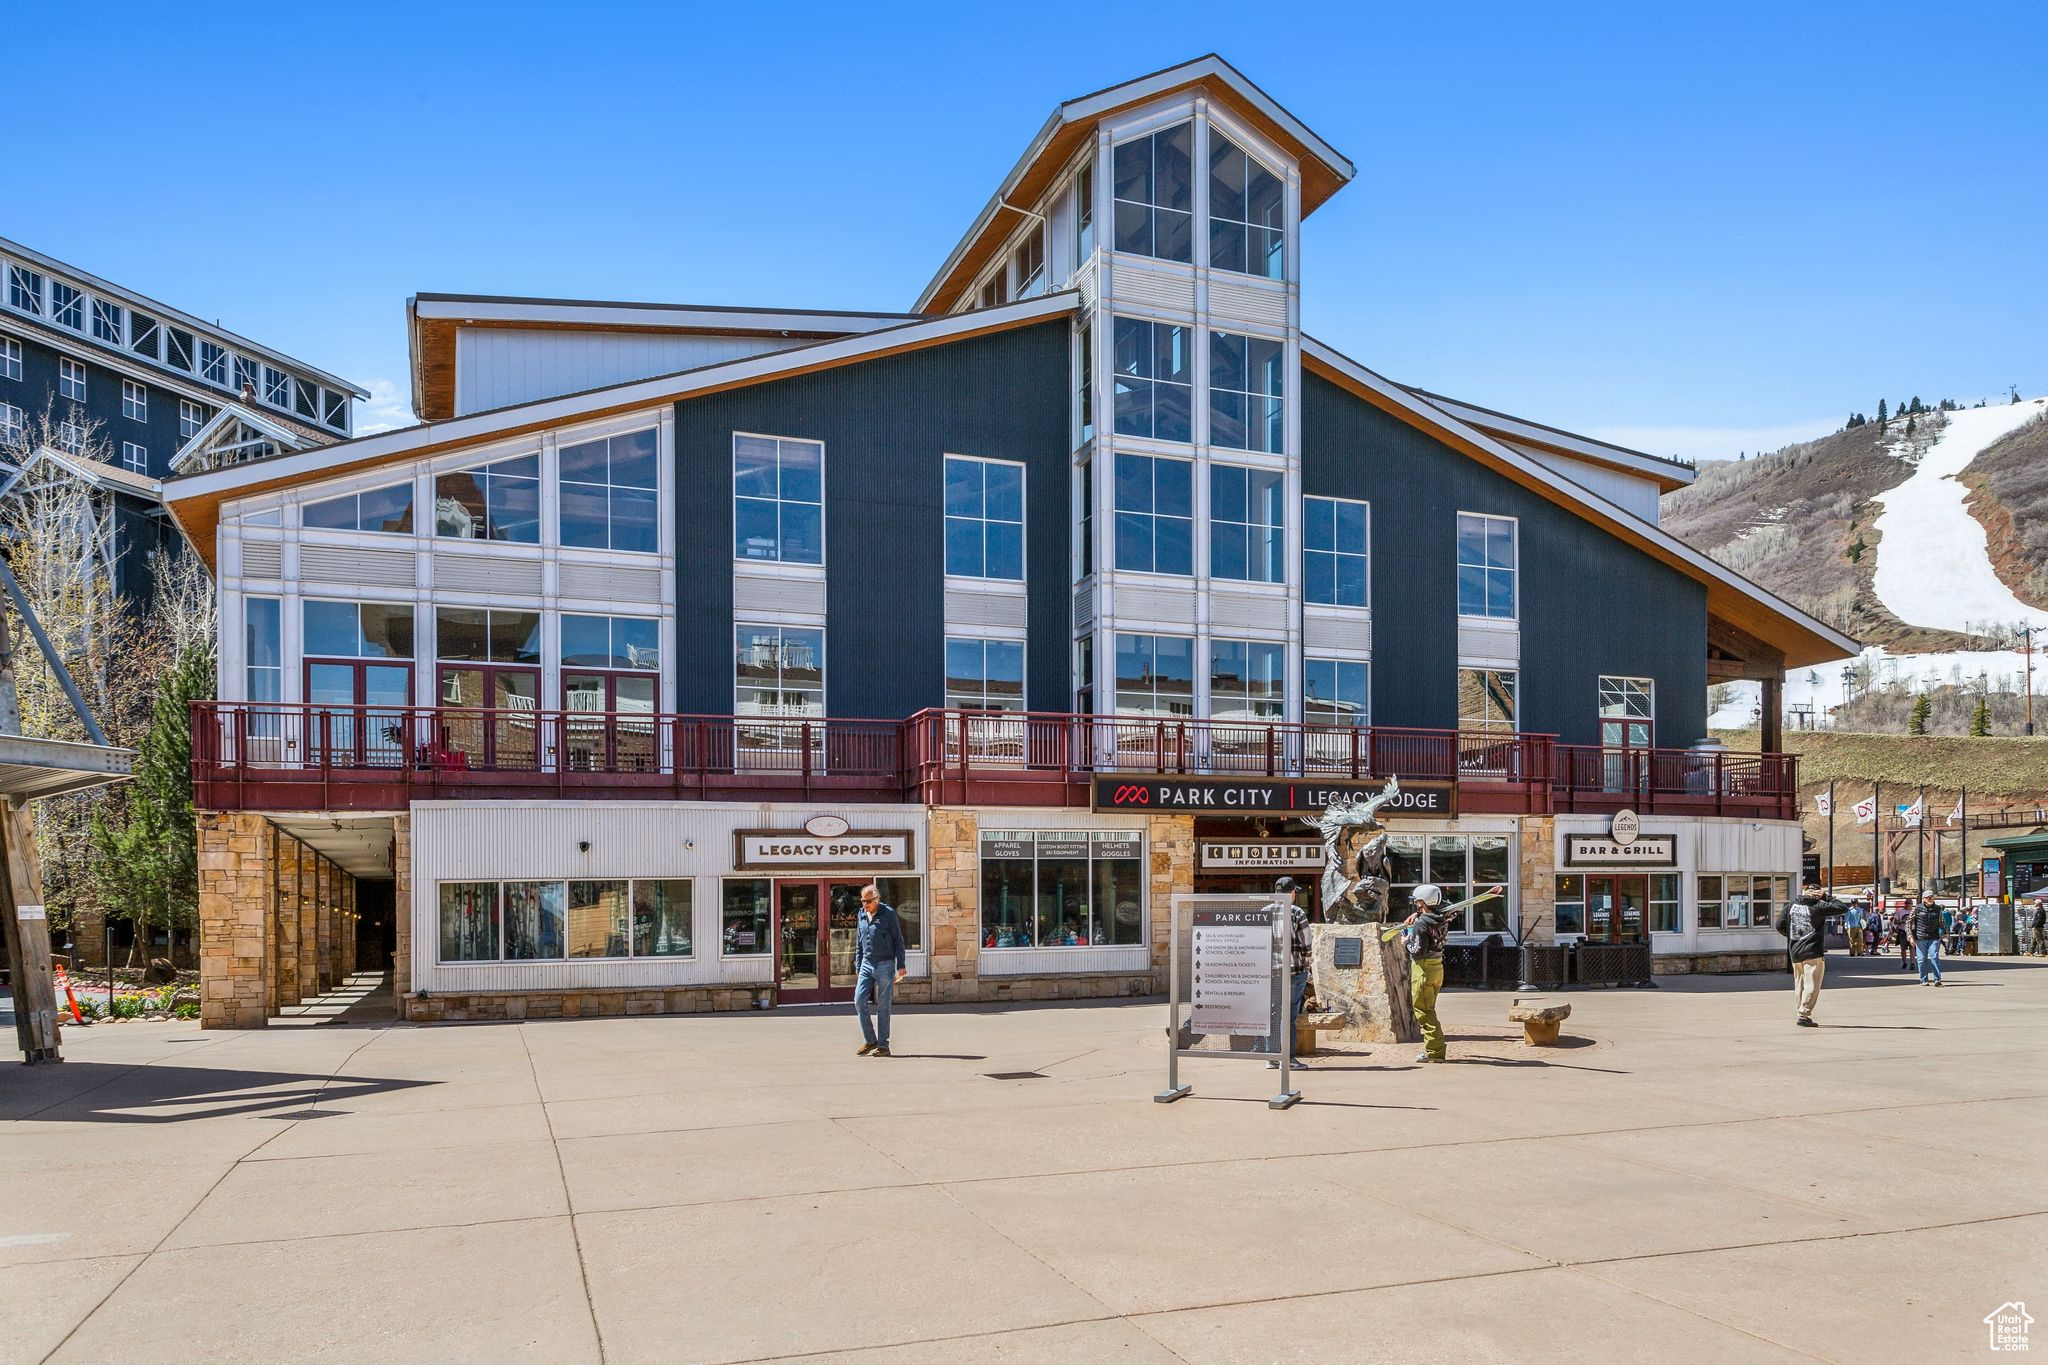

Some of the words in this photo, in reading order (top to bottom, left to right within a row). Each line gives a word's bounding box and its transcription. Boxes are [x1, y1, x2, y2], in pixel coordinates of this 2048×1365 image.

[1160, 787, 1215, 804] PARK
[1223, 789, 1273, 805] CITY
[1382, 793, 1438, 808] ODGE
[1614, 823, 1637, 831] LEGENDS
[759, 845, 824, 856] LEGACY
[829, 845, 892, 855] SPORTS
[1579, 846, 1606, 855] BAR
[1610, 847, 1619, 855] &
[1623, 847, 1664, 855] GRILL
[1215, 913, 1241, 922] PARK
[1244, 913, 1268, 922] CITY
